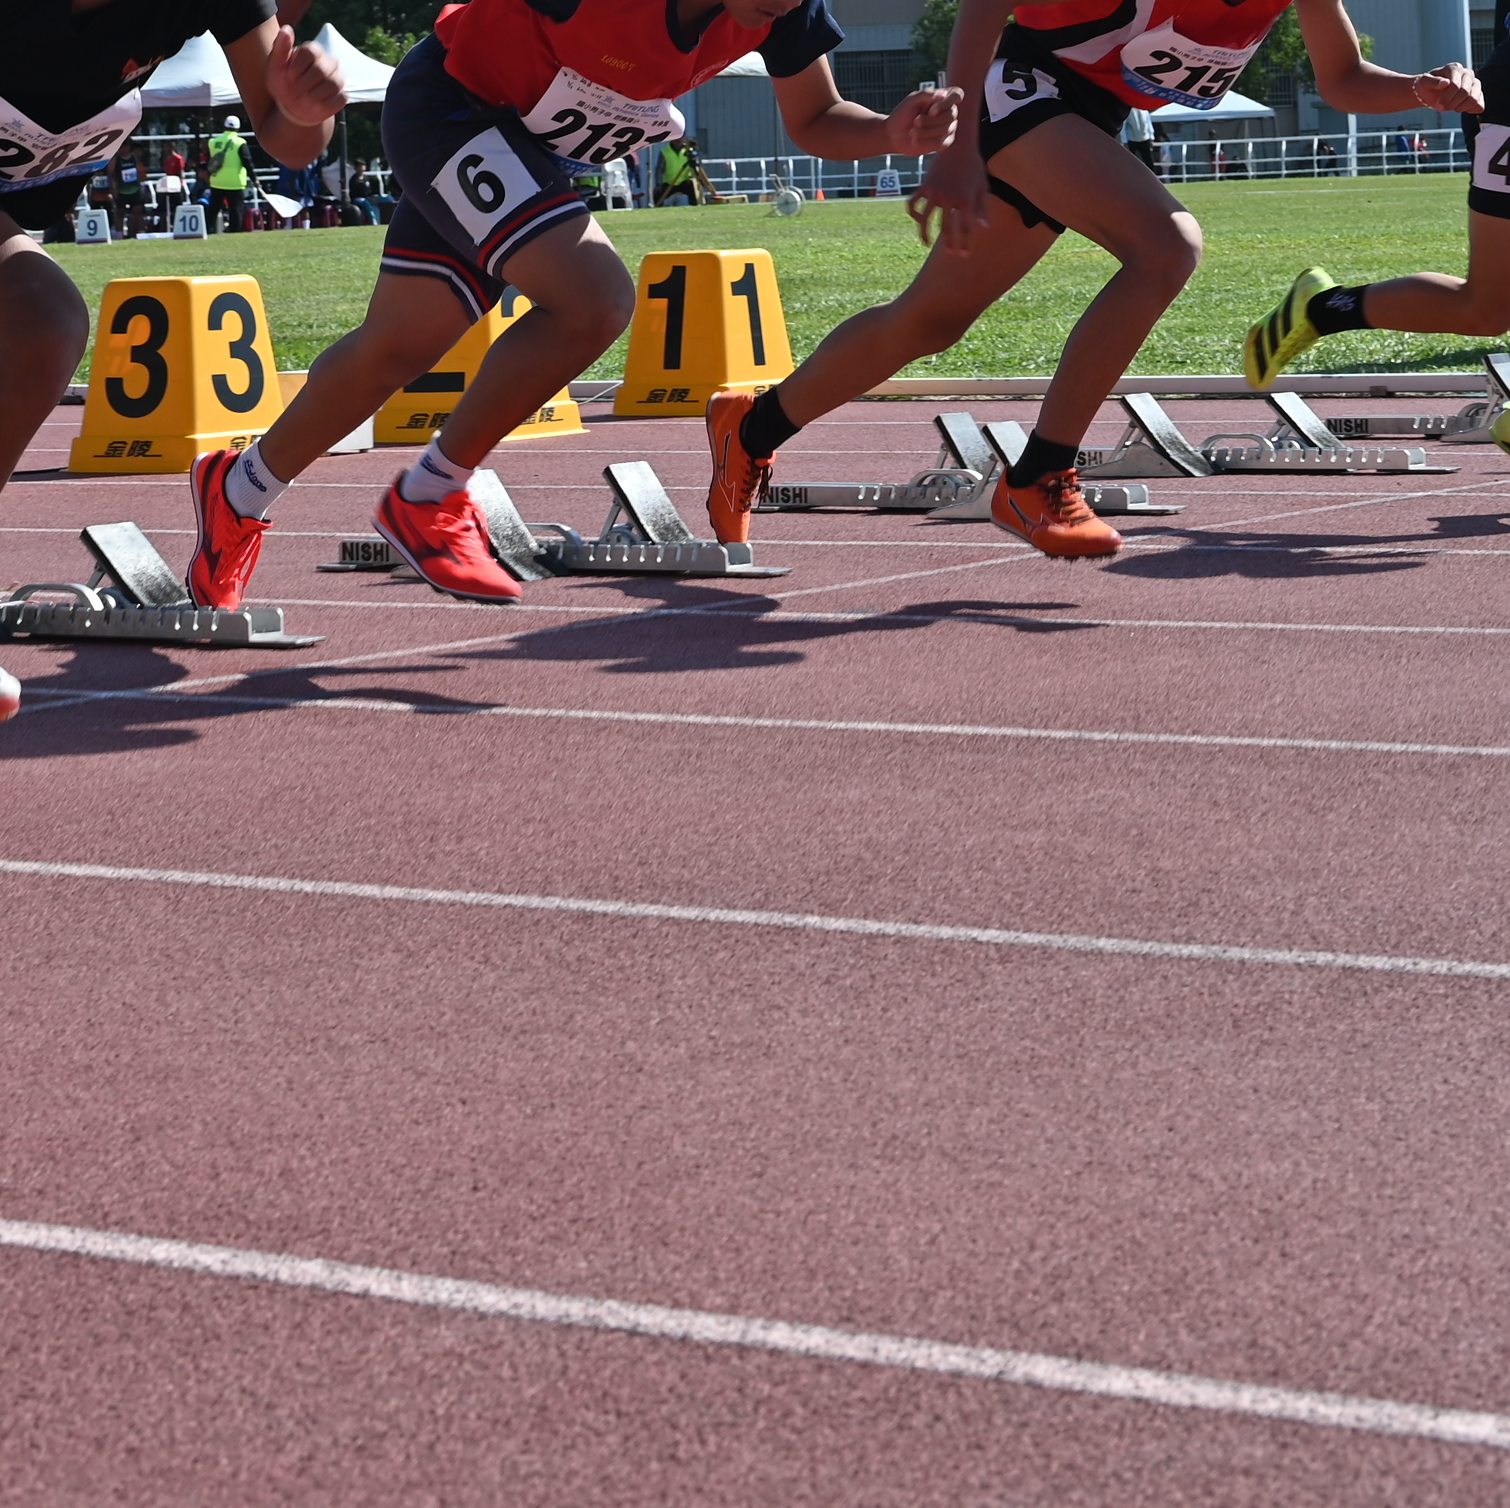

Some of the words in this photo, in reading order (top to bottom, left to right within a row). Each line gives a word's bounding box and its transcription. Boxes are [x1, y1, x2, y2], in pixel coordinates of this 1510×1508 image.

[1002, 59, 1037, 100] 5
[456, 153, 507, 214] 6
[880, 176, 896, 189] 65
[86, 219, 98, 236] 9
[179, 215, 199, 232] 10
[648, 265, 687, 370] 1
[730, 262, 766, 366] 1
[105, 296, 169, 418] 3
[207, 292, 264, 413] 3
[636, 388, 699, 403] 金陵
[1327, 419, 1369, 433] NISHI
[93, 441, 162, 458] 金陵
[763, 487, 808, 503] NISHI
[342, 543, 389, 561] NISHI
